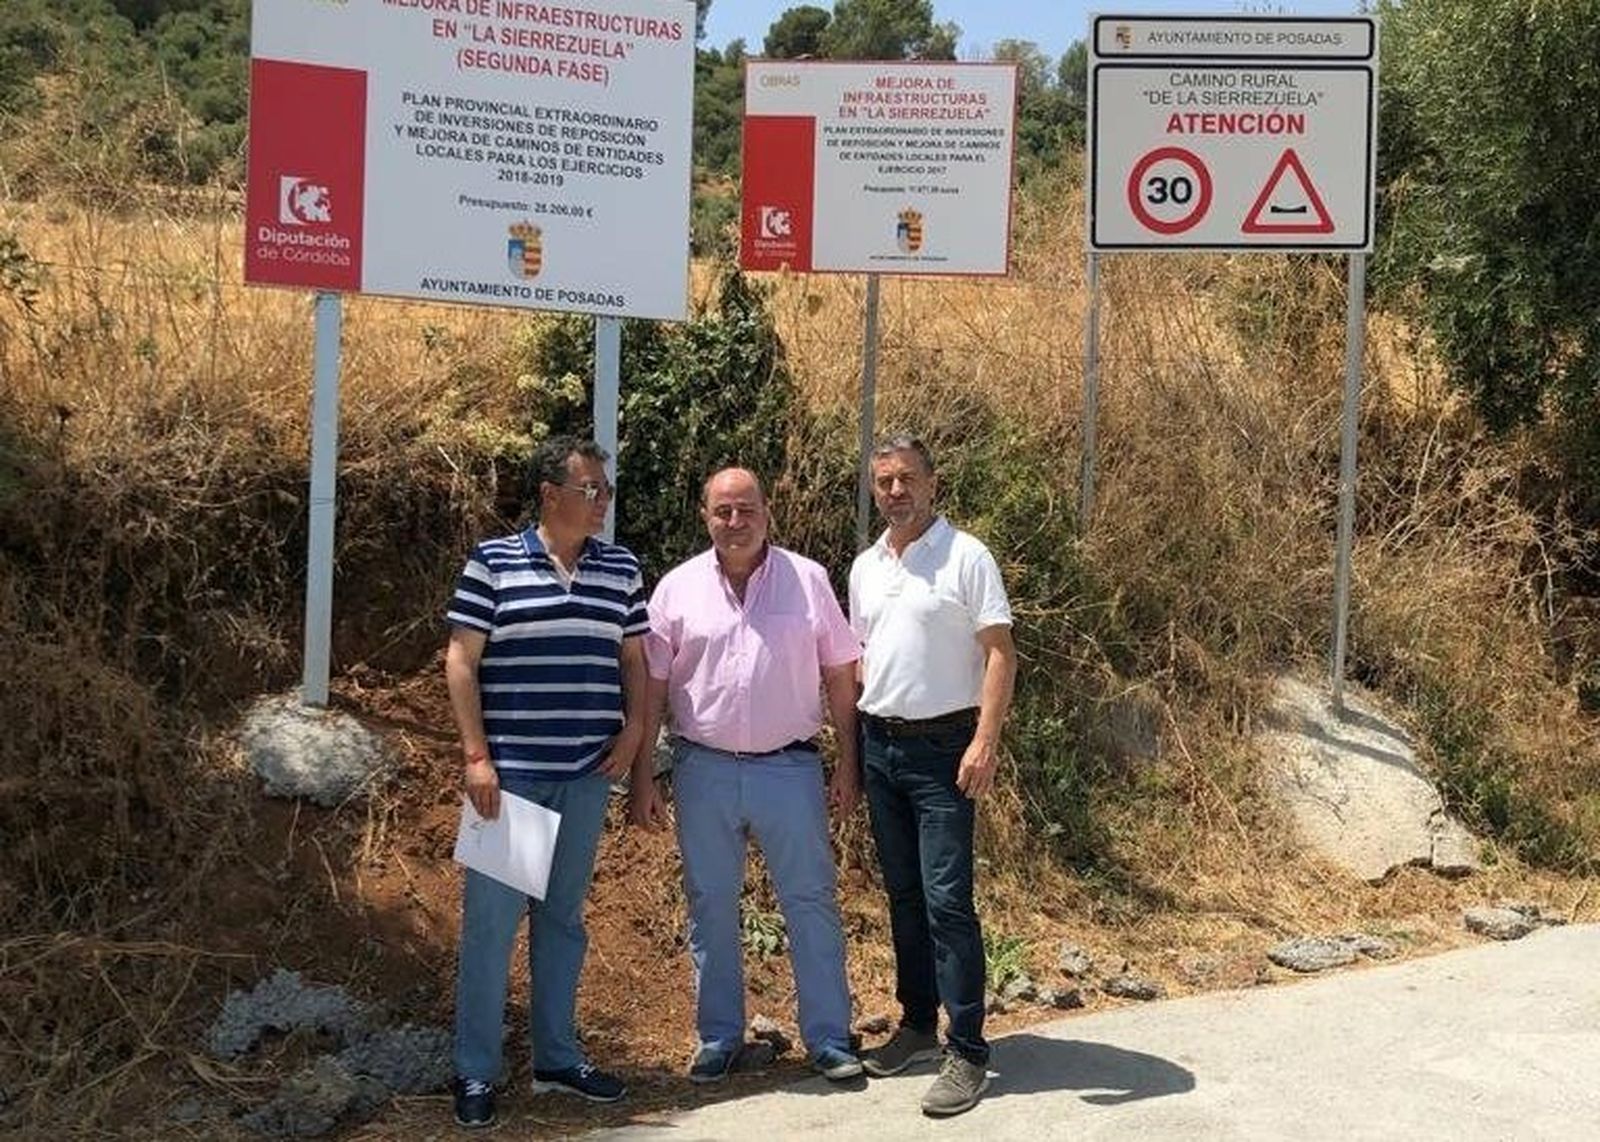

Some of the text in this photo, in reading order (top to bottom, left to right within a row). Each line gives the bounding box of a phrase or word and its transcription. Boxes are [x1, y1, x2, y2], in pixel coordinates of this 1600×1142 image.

[432, 18, 457, 38] EN
[466, 0, 491, 17] DE
[496, 2, 682, 41] INFRAESTRUCTURAS
[1147, 31, 1342, 46] AYUNTAMIENTO DE POSADAS
[458, 49, 609, 87] (SEGUNDA FASE)
[1169, 73, 1297, 88] CAMINO RURAL
[875, 76, 957, 90] MEJORA DE
[842, 91, 988, 106] INFRAESTRUCTURAS
[1177, 90, 1198, 105] LA
[402, 91, 659, 132] PLAN PROVINCIAL EXTRAORDINARIO
[415, 109, 434, 124] DE
[438, 112, 534, 134] INVERSIONES
[538, 123, 557, 138] DE
[839, 106, 858, 119] EN
[1166, 107, 1305, 134] ATENCIÓN
[394, 124, 664, 166] Y MEJORA DE CAMINOS DE ENTIDADES
[416, 143, 643, 180] LOCALES PARA LOS EJERCICIOS
[498, 168, 564, 187] 2018-2019
[1147, 176, 1192, 205] 30
[258, 226, 350, 250] Diputación
[420, 277, 625, 308] AYUNTAMIENTO DE POSADAS
